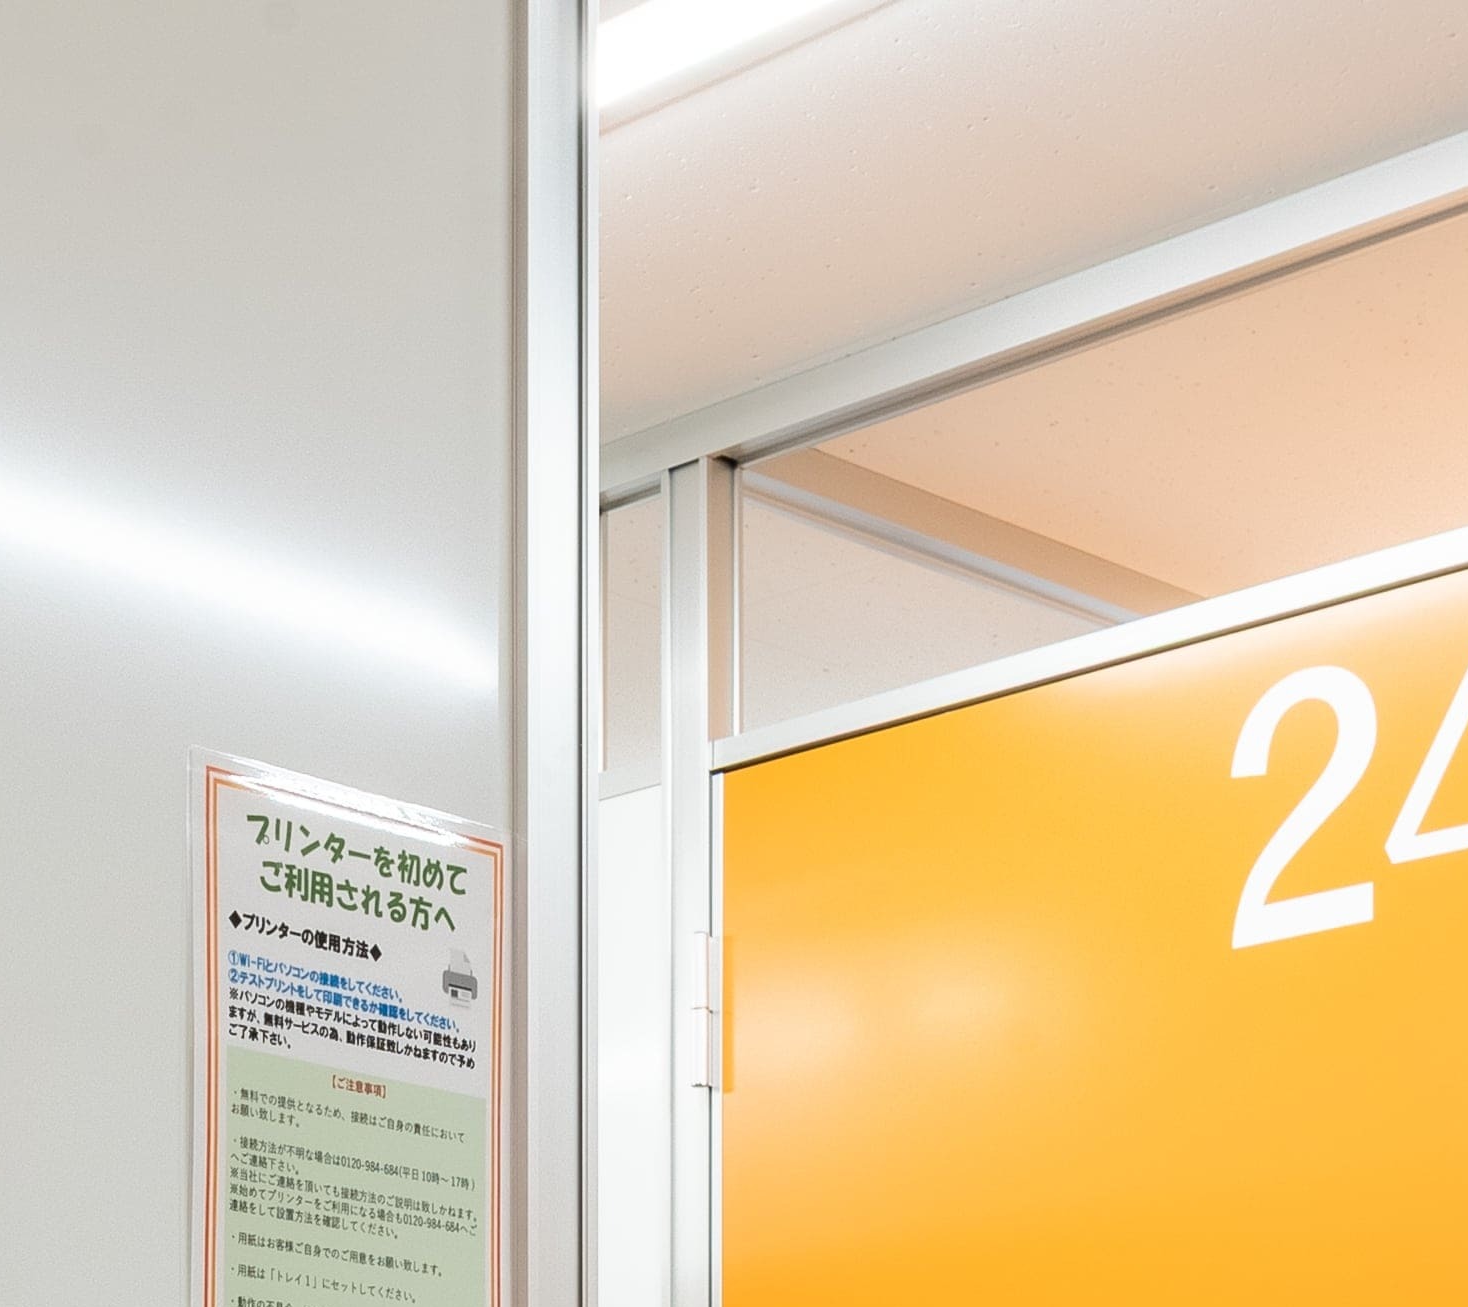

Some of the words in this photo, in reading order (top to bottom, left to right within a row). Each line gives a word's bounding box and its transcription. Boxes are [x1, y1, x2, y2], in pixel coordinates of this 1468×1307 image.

[246, 814, 468, 895] プリンターを初めて
[260, 860, 456, 932] ご利用される方へ
